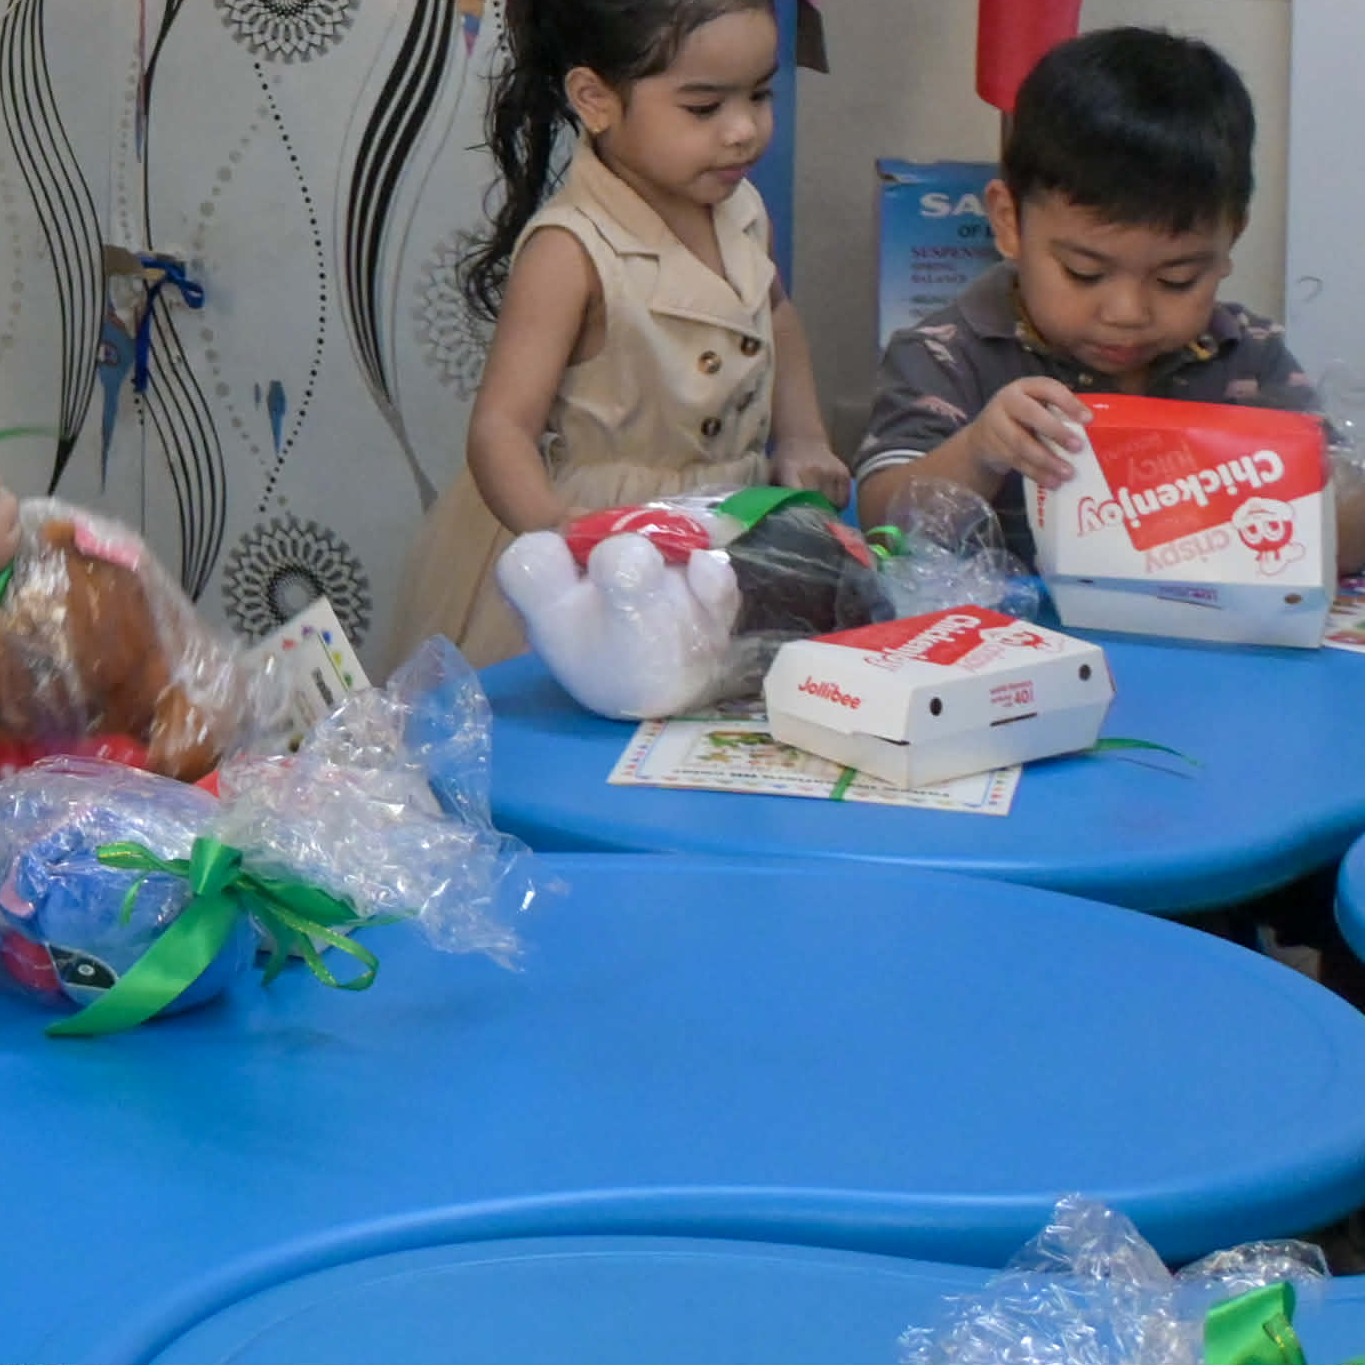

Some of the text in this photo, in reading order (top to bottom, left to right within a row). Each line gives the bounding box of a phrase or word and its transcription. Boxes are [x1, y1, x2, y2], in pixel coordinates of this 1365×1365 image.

[920, 192, 988, 218] SA
[1076, 448, 1285, 537] Chickenjoy
[1143, 526, 1231, 574] crispy
[797, 675, 862, 711] Jollibee
